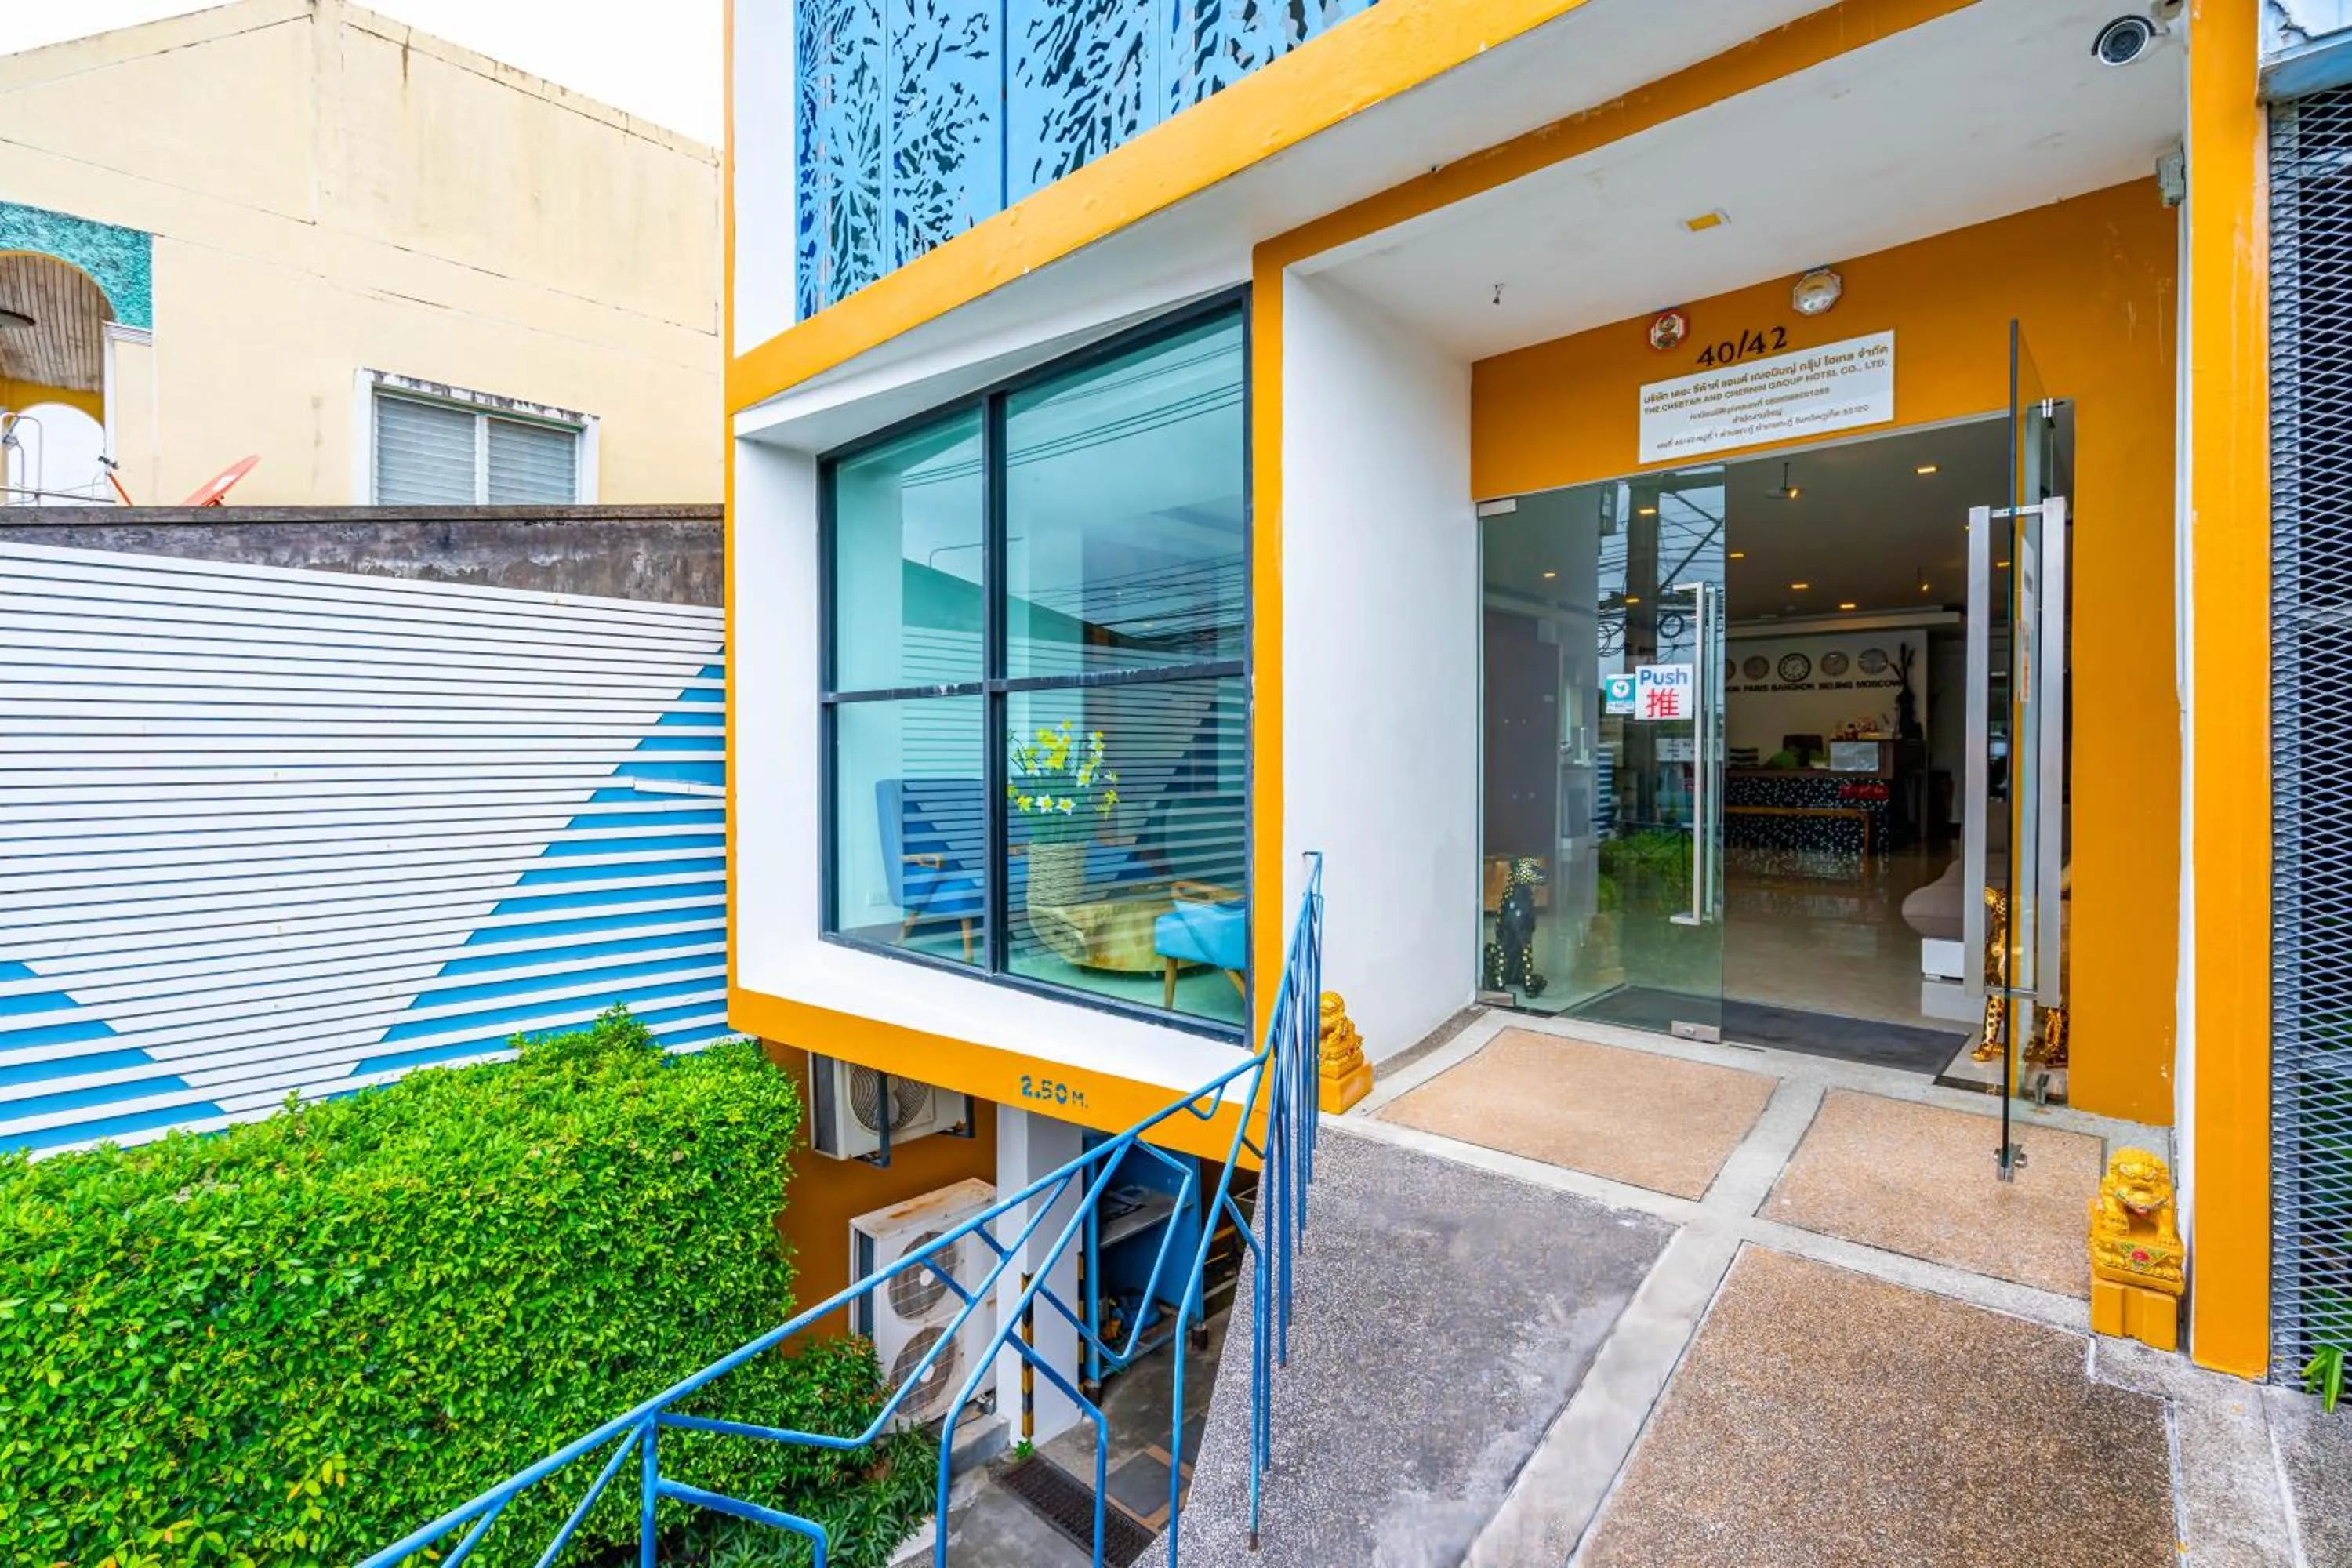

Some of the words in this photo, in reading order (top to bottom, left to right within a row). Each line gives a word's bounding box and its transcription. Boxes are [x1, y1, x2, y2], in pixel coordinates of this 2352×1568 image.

[1697, 326, 1788, 367] 40/42
[1644, 405, 1660, 415] THE
[1704, 392, 1723, 404] AND
[1768, 376, 1804, 390] GROUP
[1806, 369, 1838, 383] HOTEL
[1865, 358, 1889, 370] LTD.
[1640, 668, 1688, 686] Push
[1771, 683, 1815, 691] BANGKOK
[1645, 688, 1680, 718] 推
